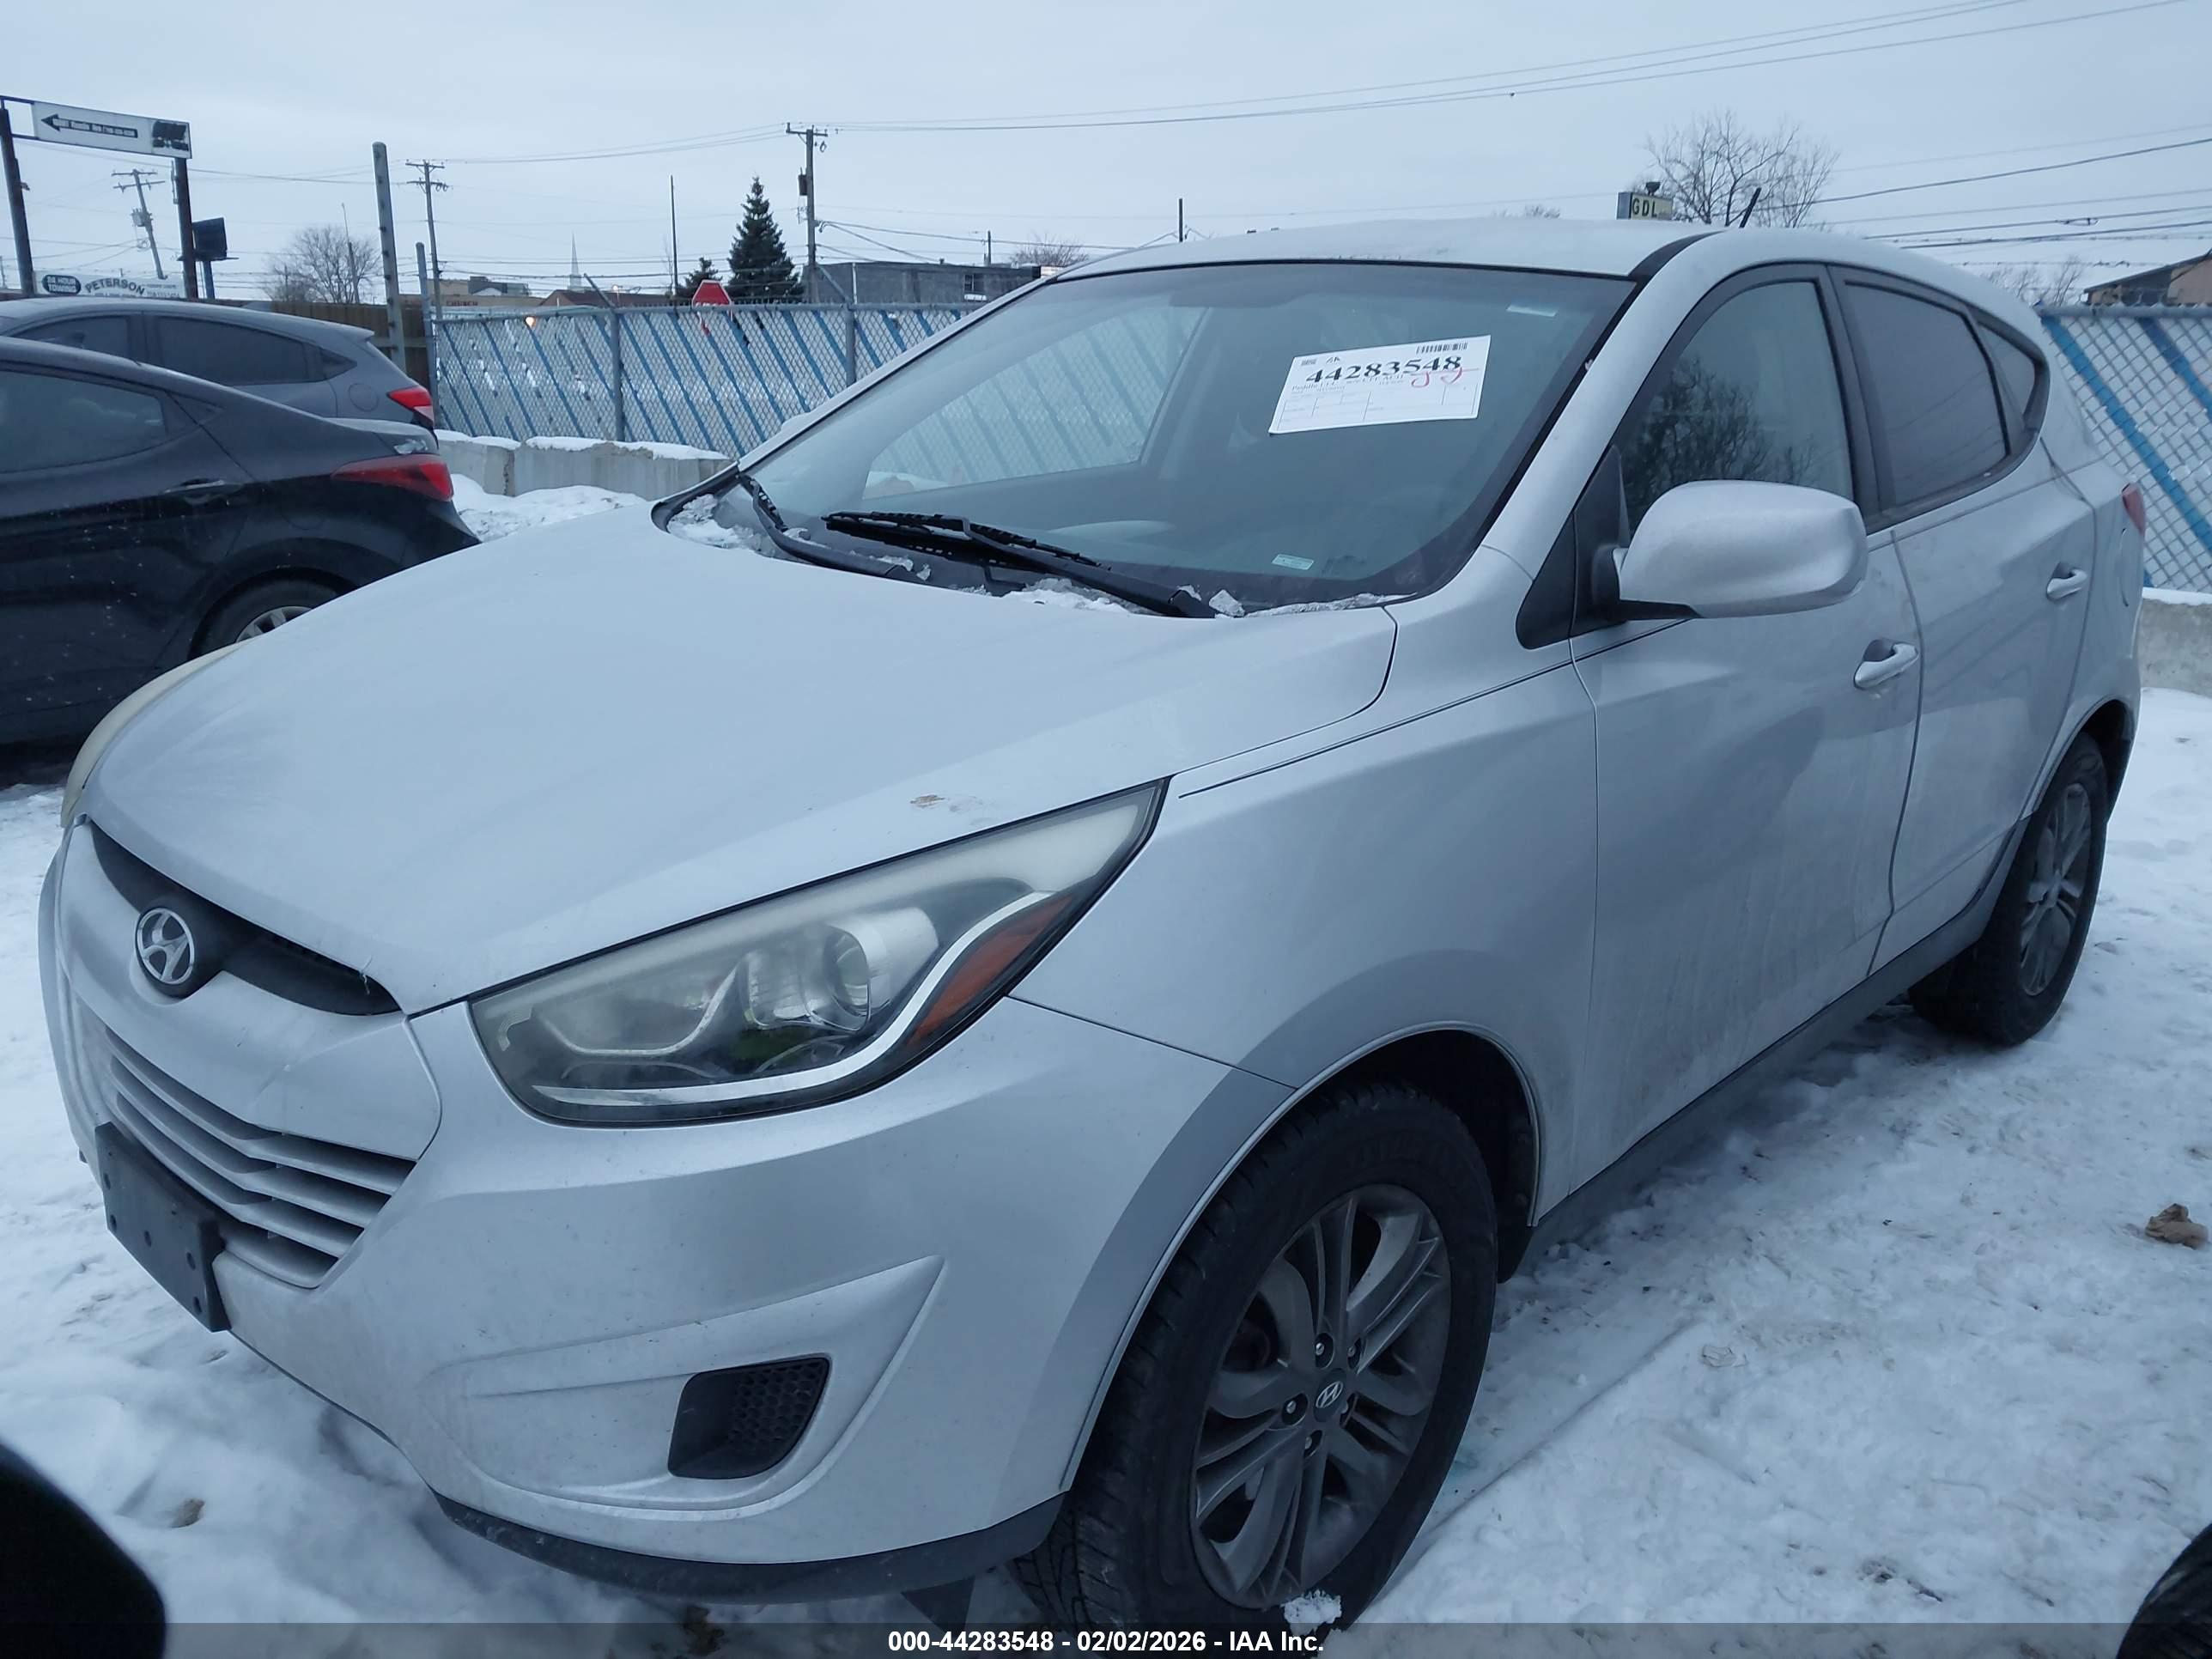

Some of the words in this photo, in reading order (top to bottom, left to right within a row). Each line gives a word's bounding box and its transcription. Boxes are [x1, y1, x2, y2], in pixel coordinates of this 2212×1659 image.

[1633, 198, 1657, 217] GDL
[85, 277, 145, 295] PETERSON
[1306, 356, 1462, 383] 44283548
